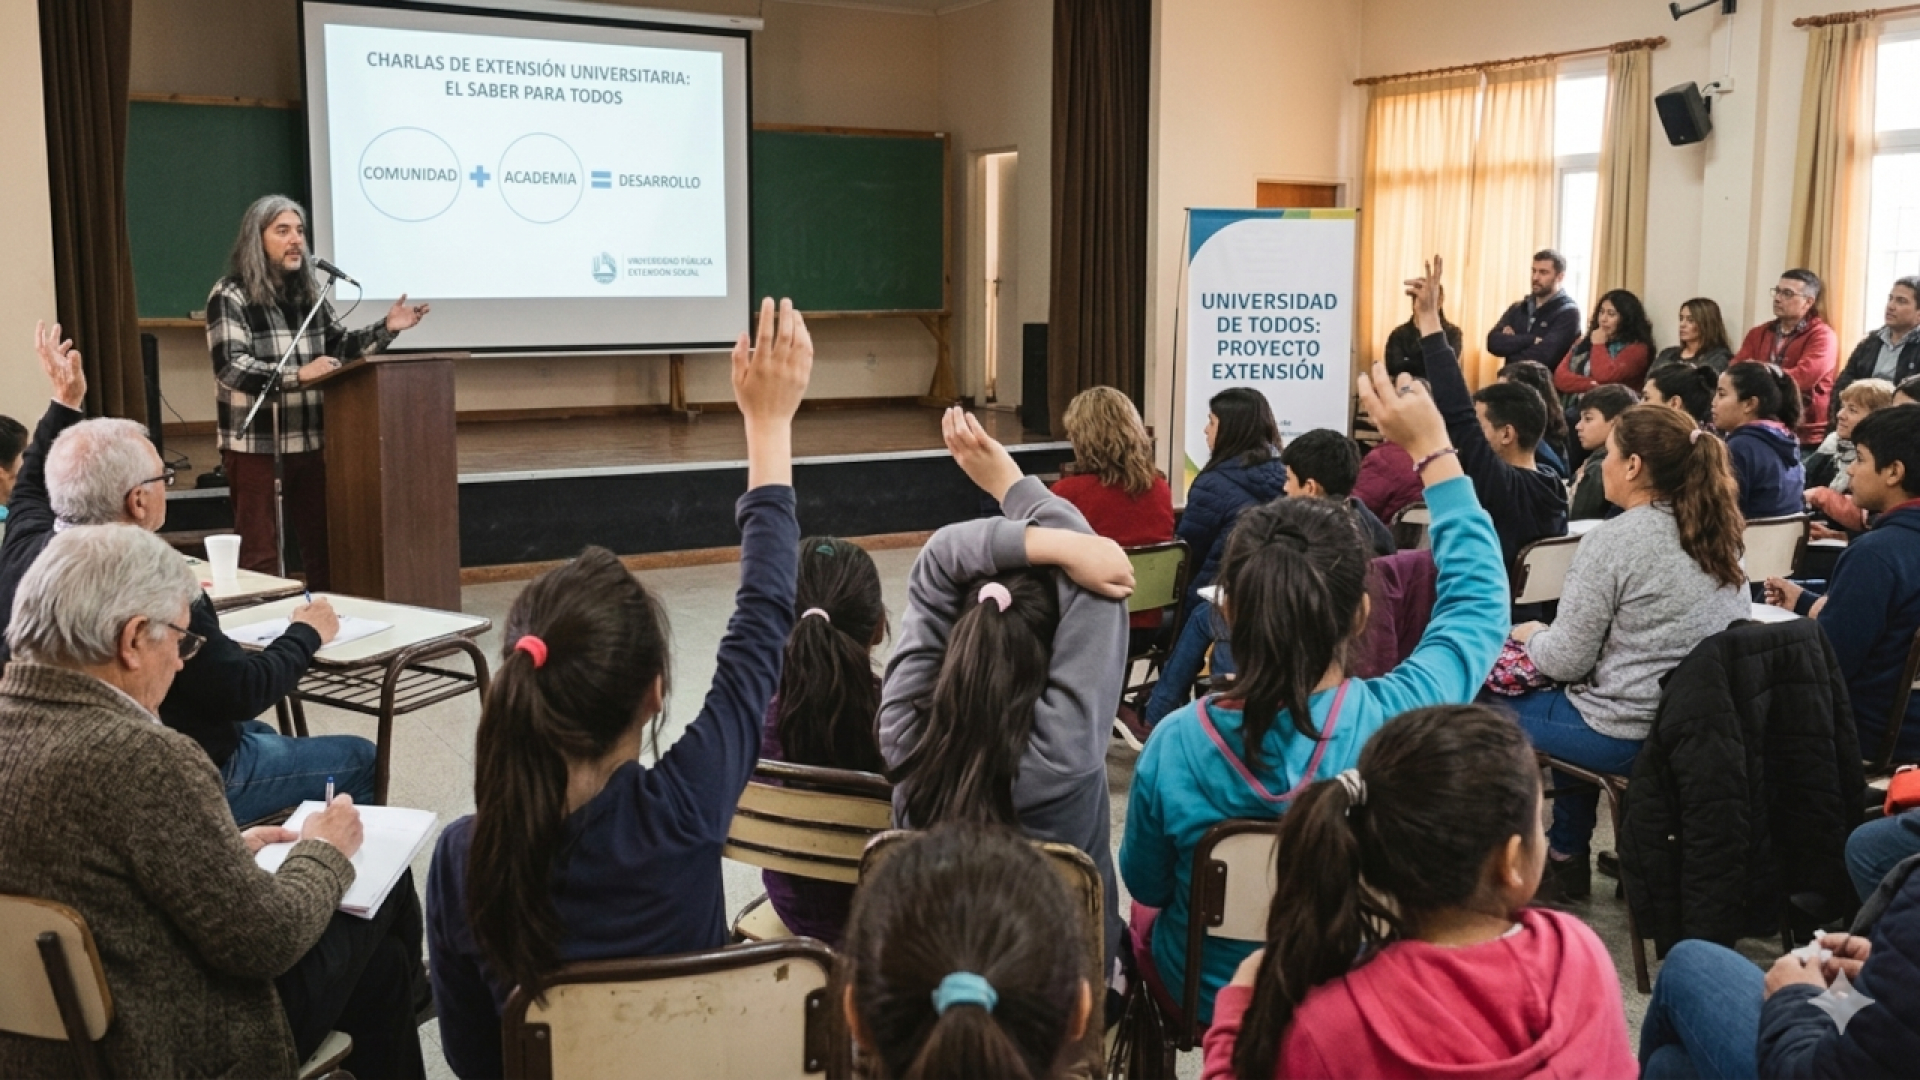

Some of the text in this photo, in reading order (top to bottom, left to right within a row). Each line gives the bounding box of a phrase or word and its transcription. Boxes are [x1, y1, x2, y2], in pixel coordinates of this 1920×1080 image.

[366, 51, 691, 86] CHARLAS DE EXTENSIÓN UNIVERSITARIA:
[445, 80, 623, 105] EL SABER PARA TODOS
[363, 166, 458, 182] COMUNIDAD
[504, 171, 577, 185] ACADEMIA
[619, 173, 701, 189] DESARROLLO
[1202, 293, 1338, 309] UNIVERSIDAD
[1217, 316, 1321, 334] DE TODOS:
[1217, 340, 1320, 357] PROYECTO
[1212, 359, 1324, 380] EXTENSIÓN
